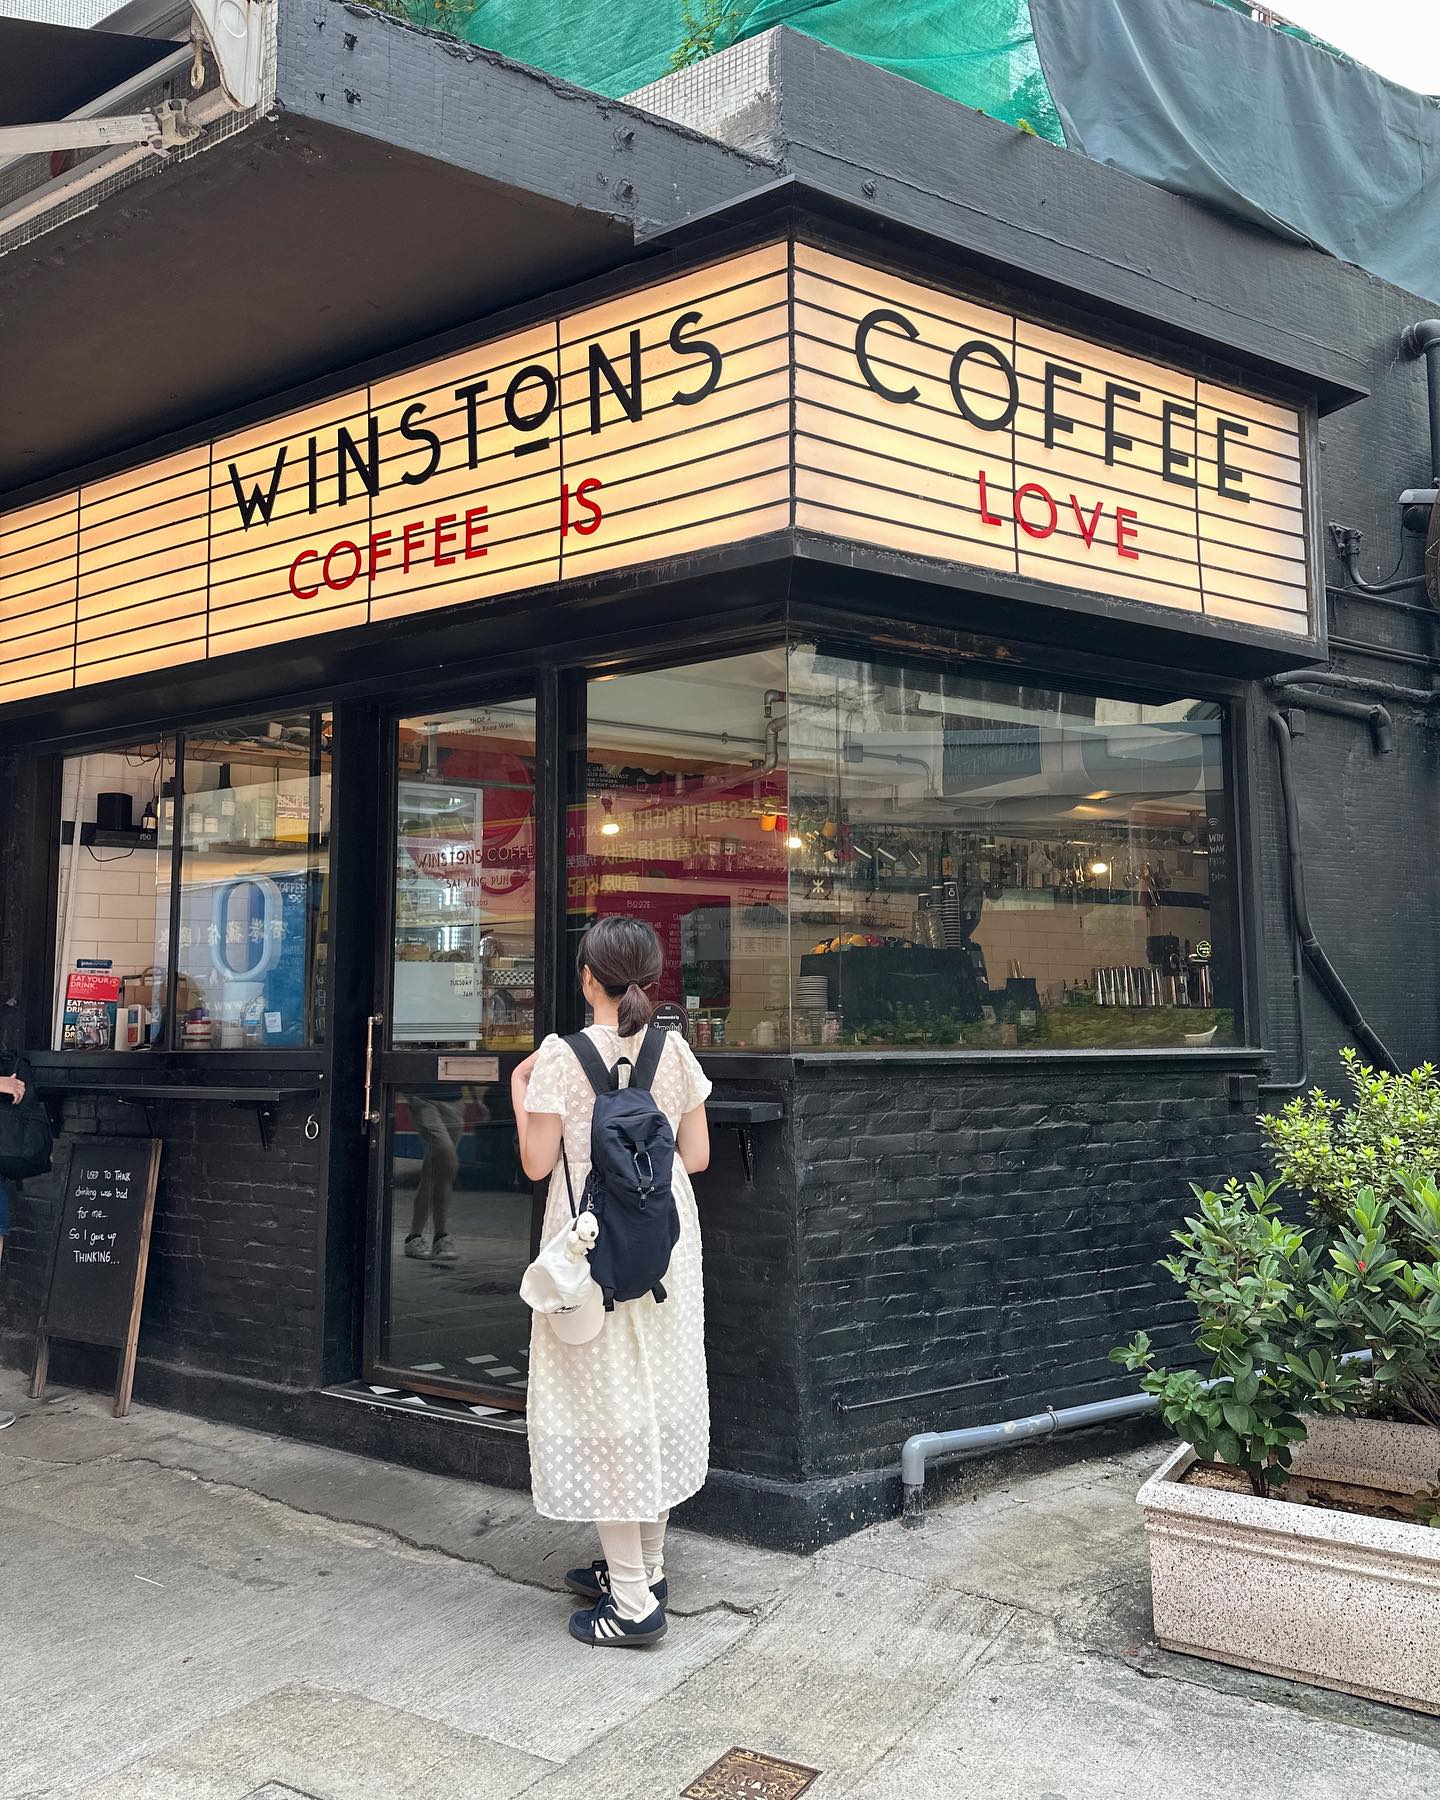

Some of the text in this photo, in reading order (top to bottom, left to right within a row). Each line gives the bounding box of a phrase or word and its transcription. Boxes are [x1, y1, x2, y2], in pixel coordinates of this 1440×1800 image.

[855, 309, 1250, 503] COFFEE
[228, 311, 722, 532] WINSTONS
[978, 470, 1140, 560] LOVE
[289, 477, 602, 599] COFFEE IS
[415, 849, 483, 869] WINSTONS
[446, 875, 509, 889] SAI YING PUN
[88, 976, 109, 984] YOUR
[77, 1206, 89, 1219] for
[68, 1227, 80, 1240] So
[90, 1233, 105, 1246] gave
[107, 1232, 117, 1247] up
